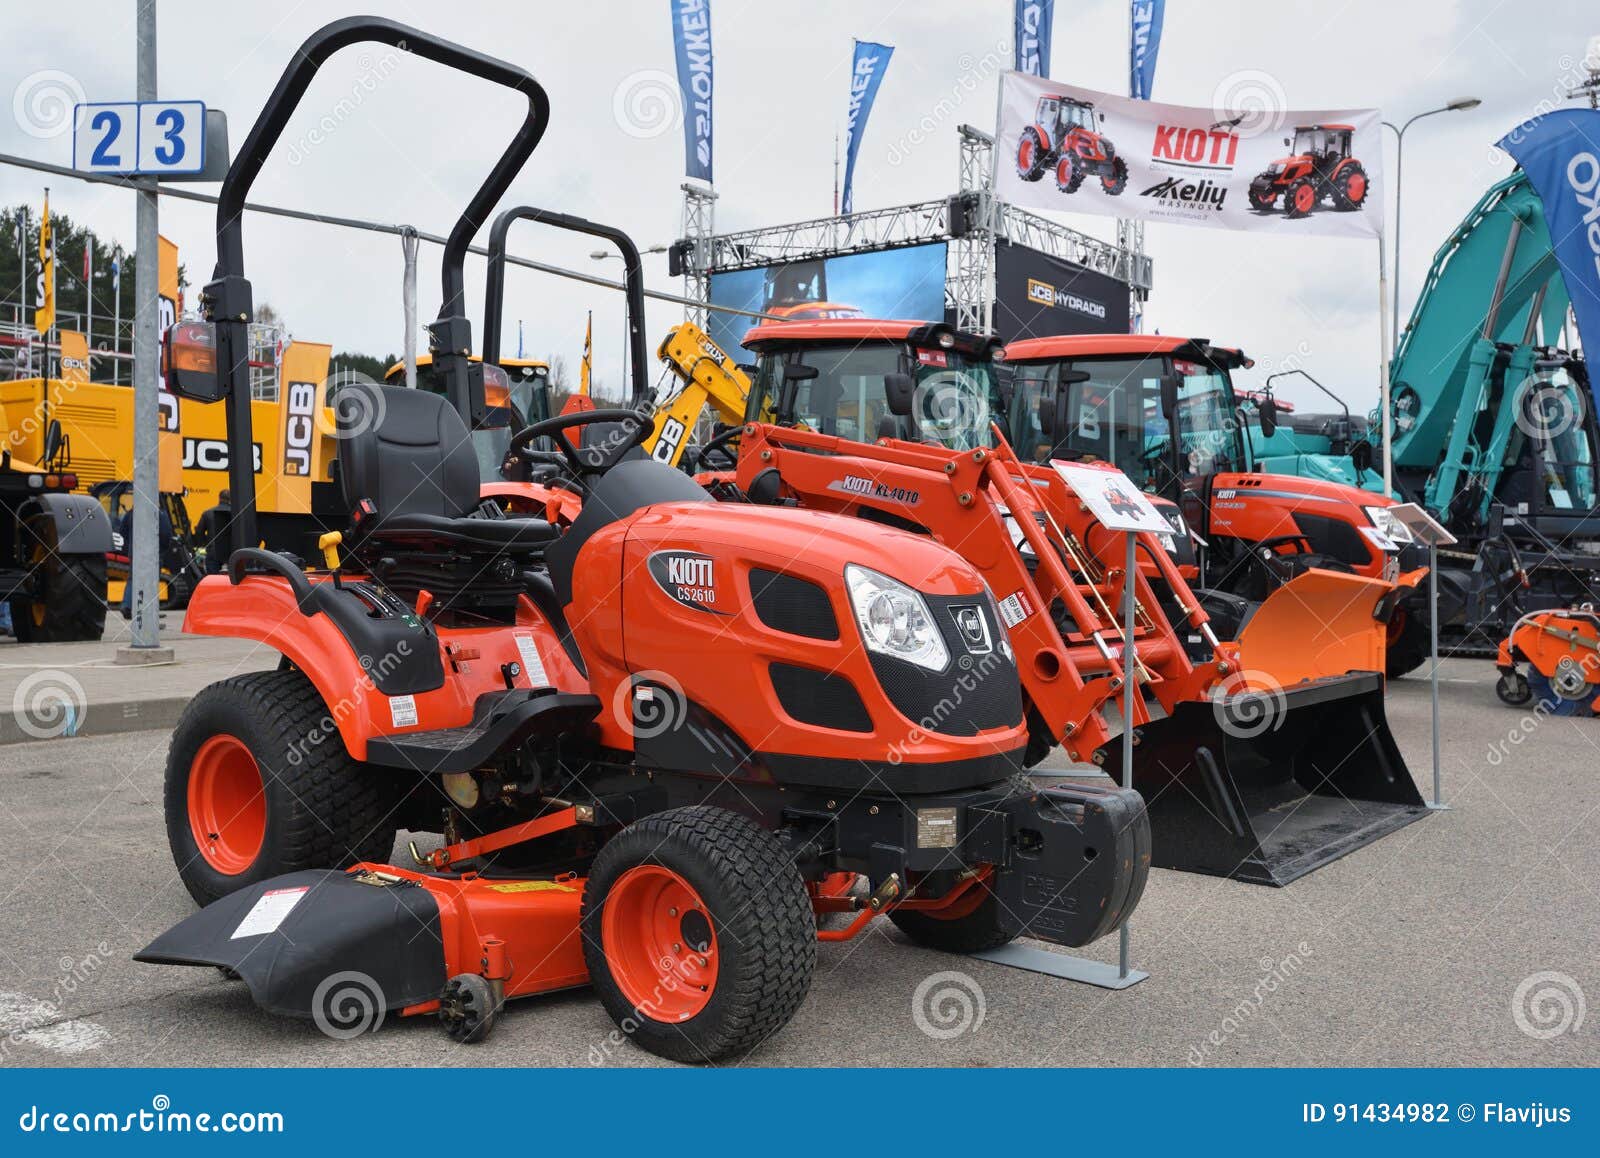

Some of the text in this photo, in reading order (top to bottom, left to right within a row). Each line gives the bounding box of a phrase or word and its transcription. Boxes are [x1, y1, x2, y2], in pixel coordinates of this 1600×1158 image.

[1152, 125, 1239, 165] KIOTI
[1031, 285, 1106, 318] JCB HYDRADIG
[288, 383, 314, 475] JCB
[653, 418, 684, 465] CB
[843, 475, 919, 503] KIOTI KL4010
[668, 557, 713, 587] KIOTI
[677, 587, 715, 603] CS2610
